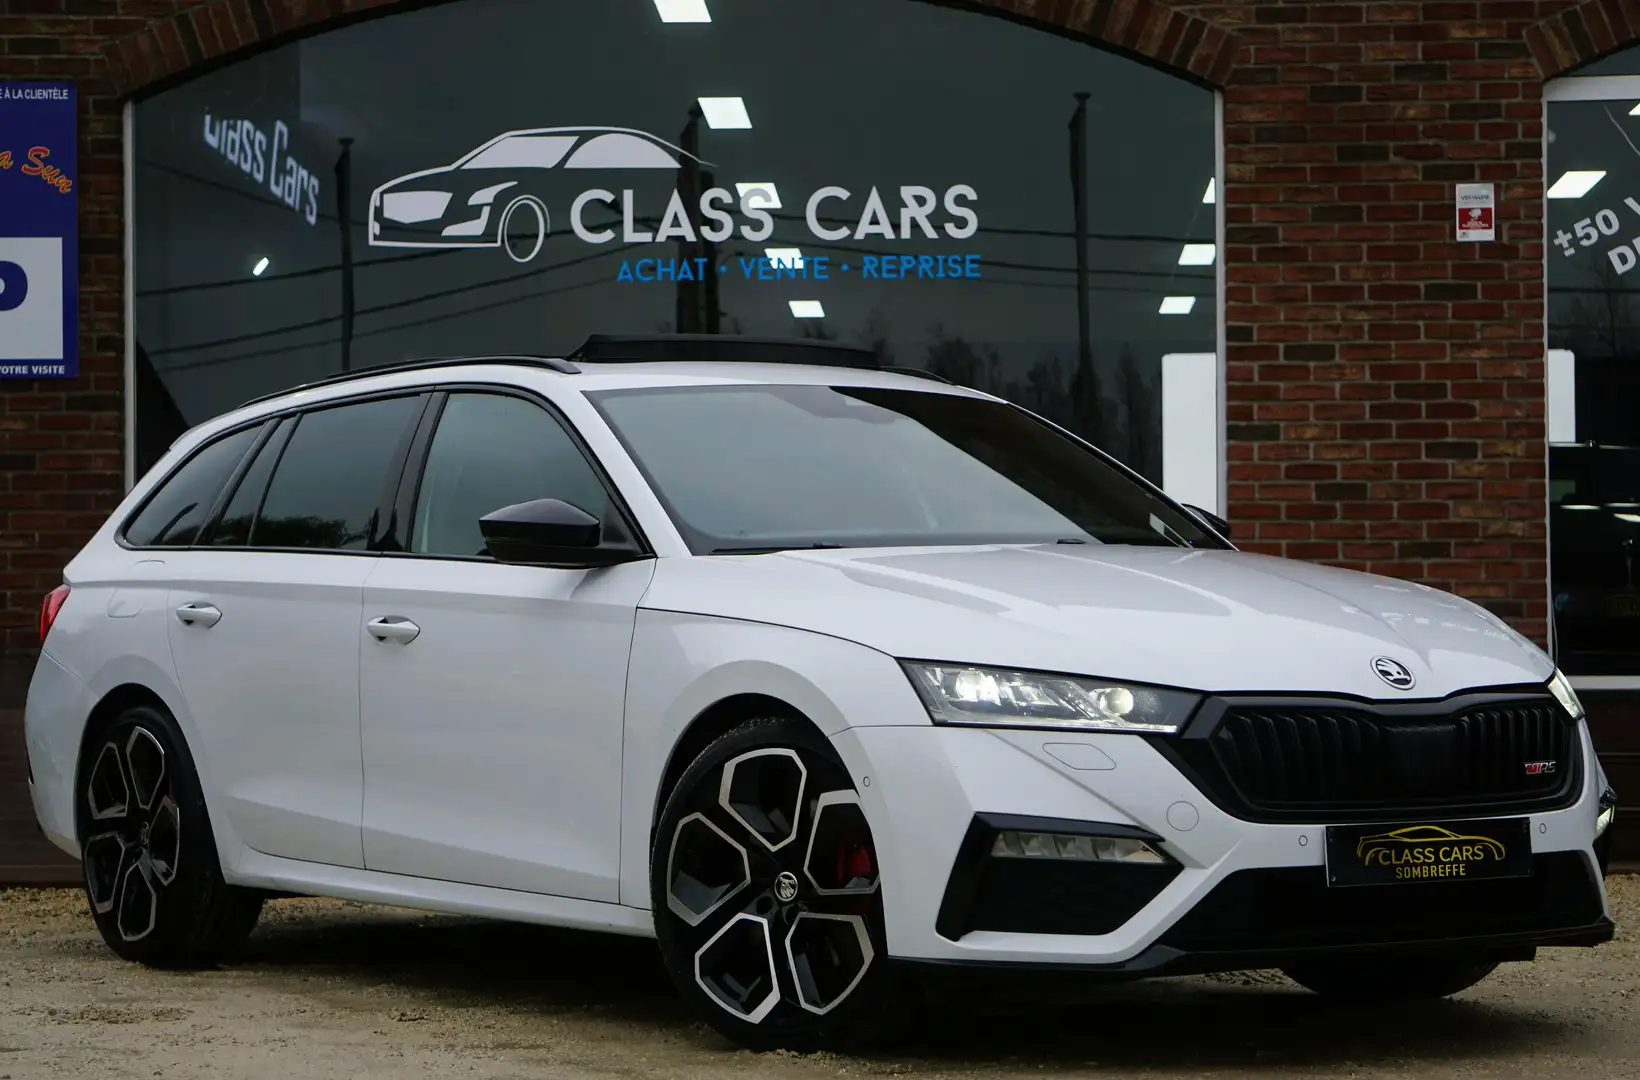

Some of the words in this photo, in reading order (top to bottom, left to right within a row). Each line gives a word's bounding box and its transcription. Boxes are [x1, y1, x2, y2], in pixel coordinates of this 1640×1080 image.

[12, 88, 23, 99] LA
[24, 86, 68, 99] CLIENTÈLE
[270, 120, 319, 226] Cars
[570, 187, 774, 243] CLASS
[806, 185, 978, 241] CARS
[617, 257, 709, 282] ACHAT
[738, 256, 830, 281] VENTE
[862, 254, 981, 279] REPRISE
[0, 365, 28, 375] OTRE
[31, 365, 65, 375] VISITE
[1378, 847, 1434, 866] CLASS
[1439, 845, 1484, 863] CARS
[1396, 863, 1467, 879] SOMBREFFE
